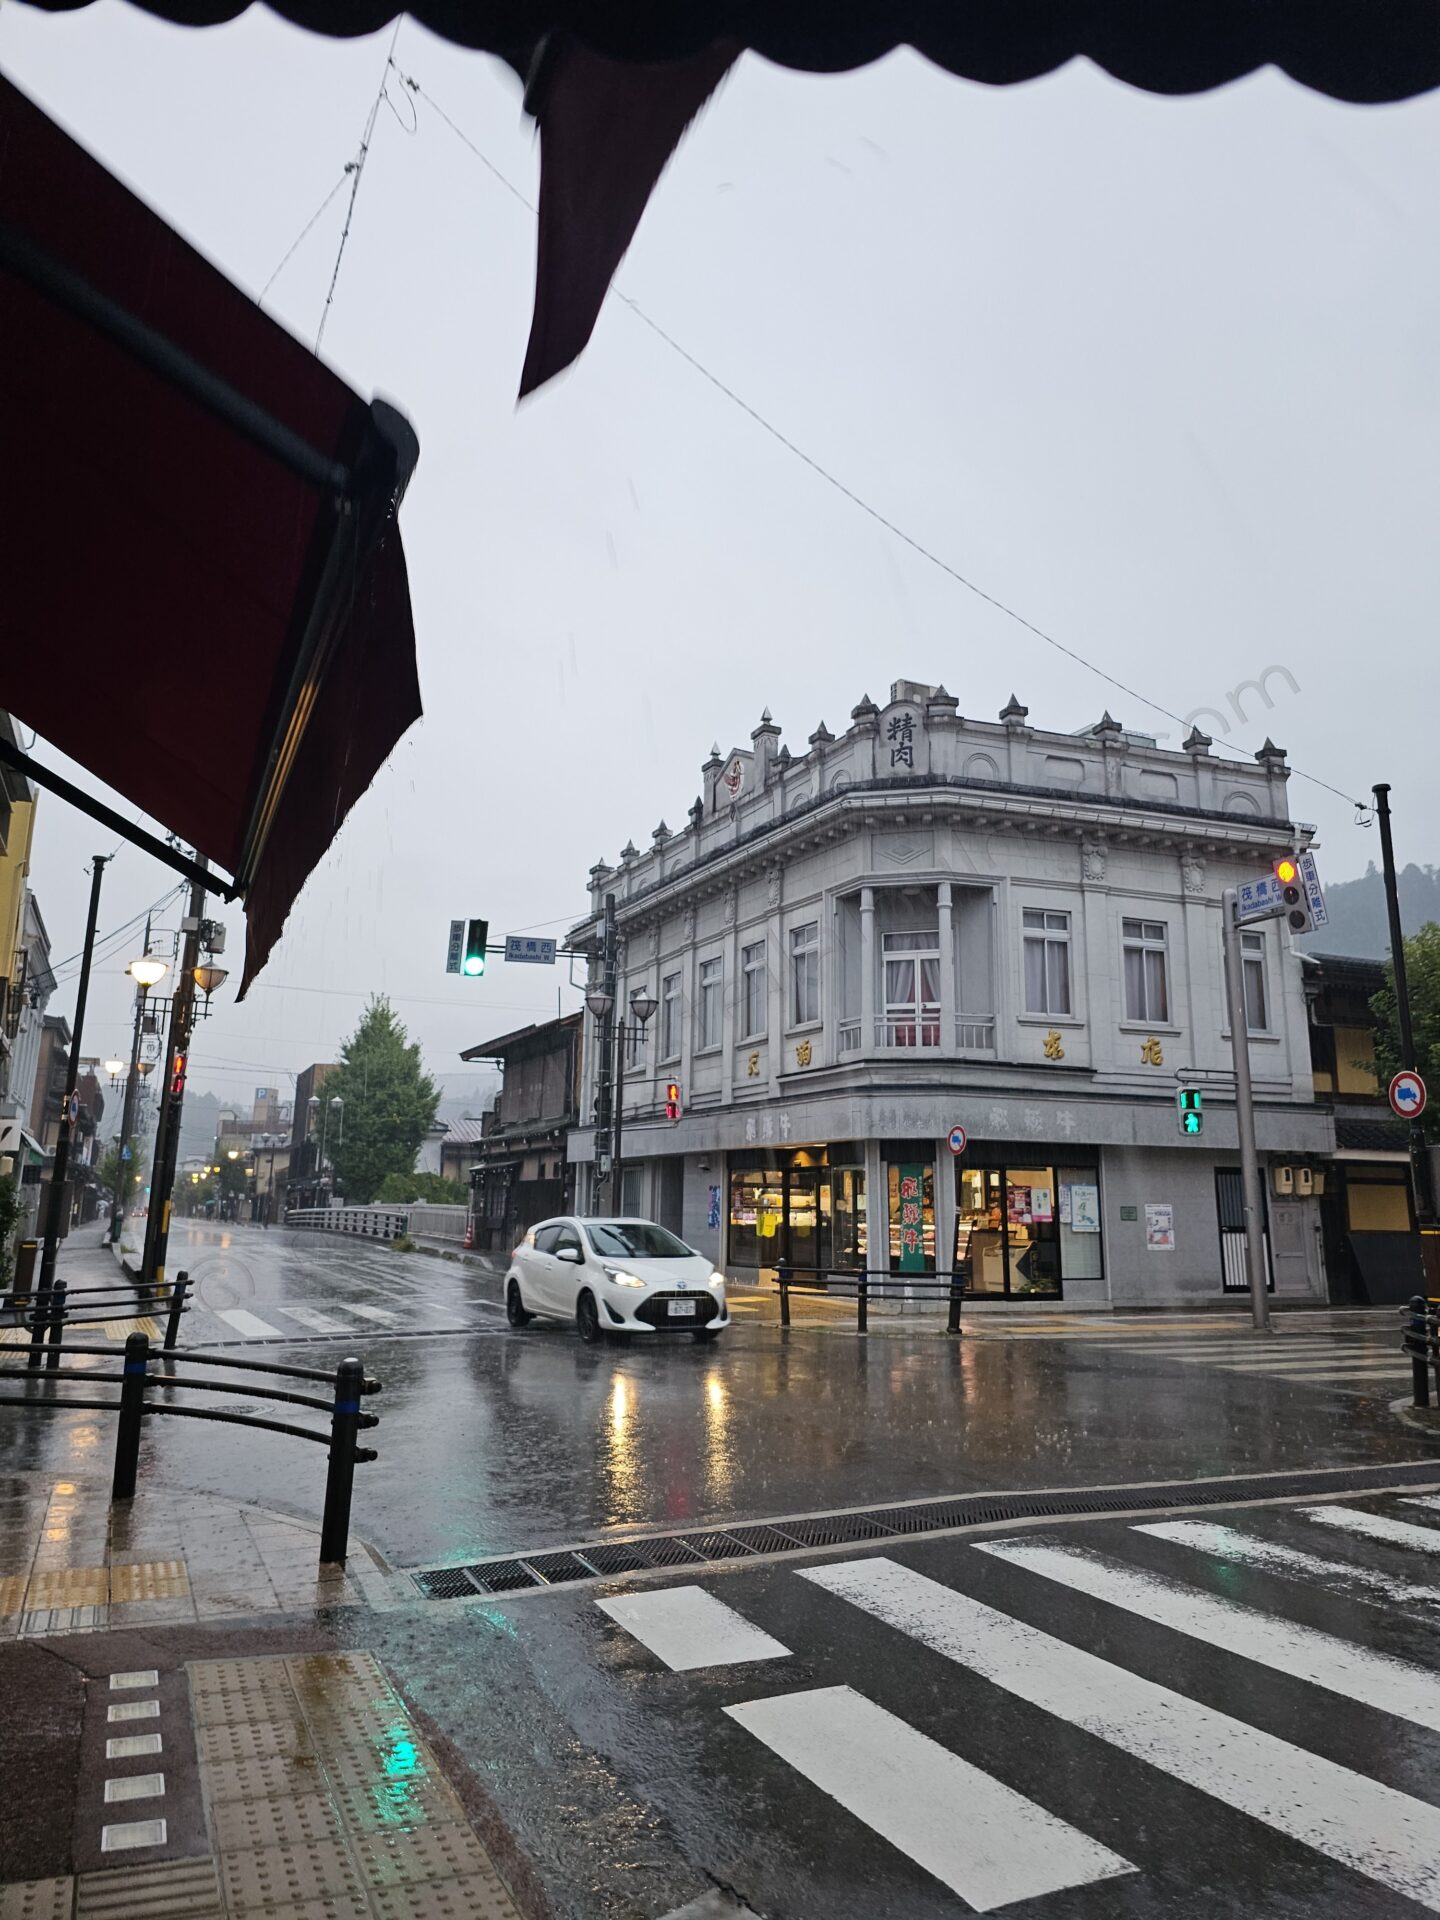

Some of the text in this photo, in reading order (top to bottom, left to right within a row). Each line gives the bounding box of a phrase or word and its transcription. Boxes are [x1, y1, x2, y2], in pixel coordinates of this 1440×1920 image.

[887, 713, 917, 768] 精肉
[1302, 858, 1326, 921] 歩車分離式
[510, 940, 552, 953] 筏橋西
